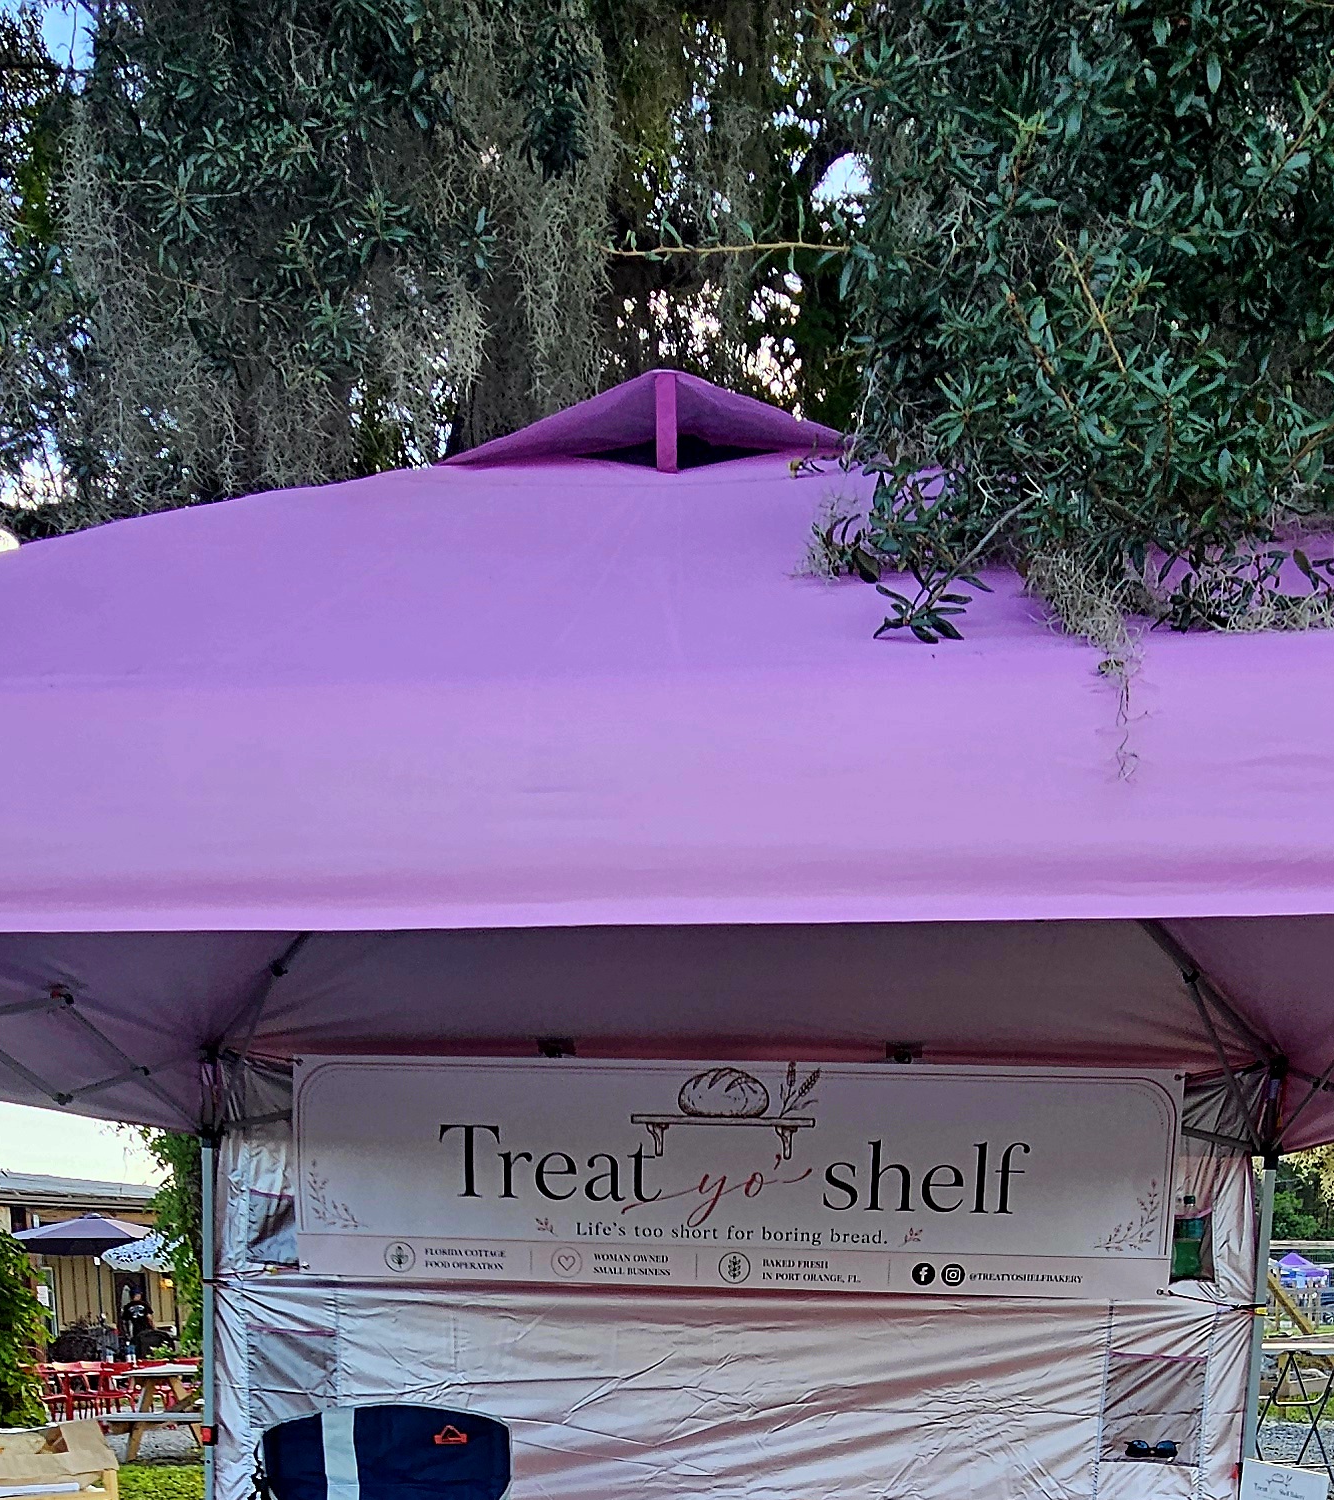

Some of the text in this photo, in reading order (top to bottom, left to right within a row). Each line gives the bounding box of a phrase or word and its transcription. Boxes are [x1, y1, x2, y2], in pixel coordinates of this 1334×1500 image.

[439, 1124, 662, 1201] Treat
[822, 1139, 1031, 1214] shelf
[576, 1222, 888, 1245] Life's too short for boring bread.
[425, 1248, 506, 1258] FLORIDA COTTAGE
[594, 1253, 669, 1263] WOMAN OWNED
[425, 1261, 503, 1270] FOOD OPERATION
[762, 1259, 828, 1269] BAKED FRESH
[593, 1267, 671, 1276] SMALL BUSINESS
[762, 1272, 772, 1280] IN
[776, 1273, 801, 1281] PORT
[803, 1274, 845, 1283] ORANGE,
[969, 1272, 1083, 1283] @TREATYOSHELFBAKERY
